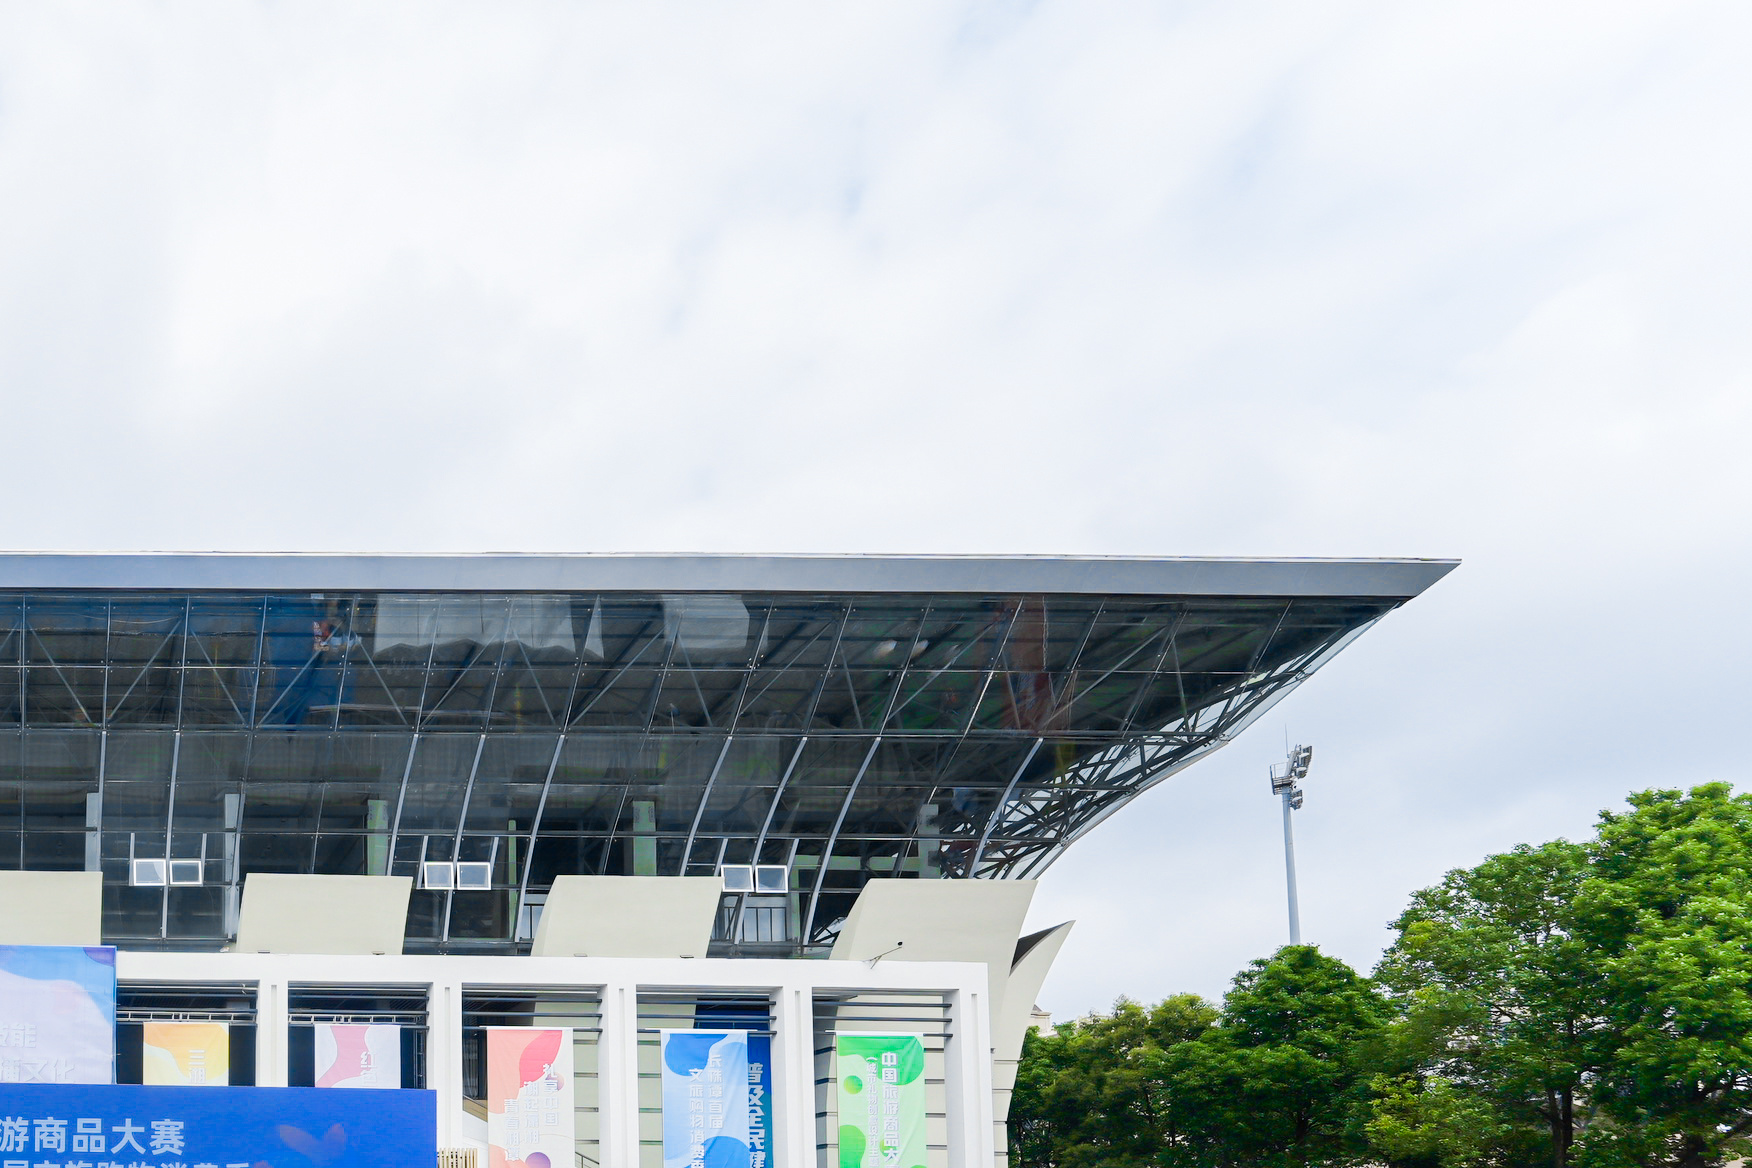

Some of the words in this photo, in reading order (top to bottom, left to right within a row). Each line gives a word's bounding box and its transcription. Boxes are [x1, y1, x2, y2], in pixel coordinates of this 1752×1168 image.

[543, 1063, 559, 1126] 礼享中国
[707, 1054, 723, 1130] 长株潭首届
